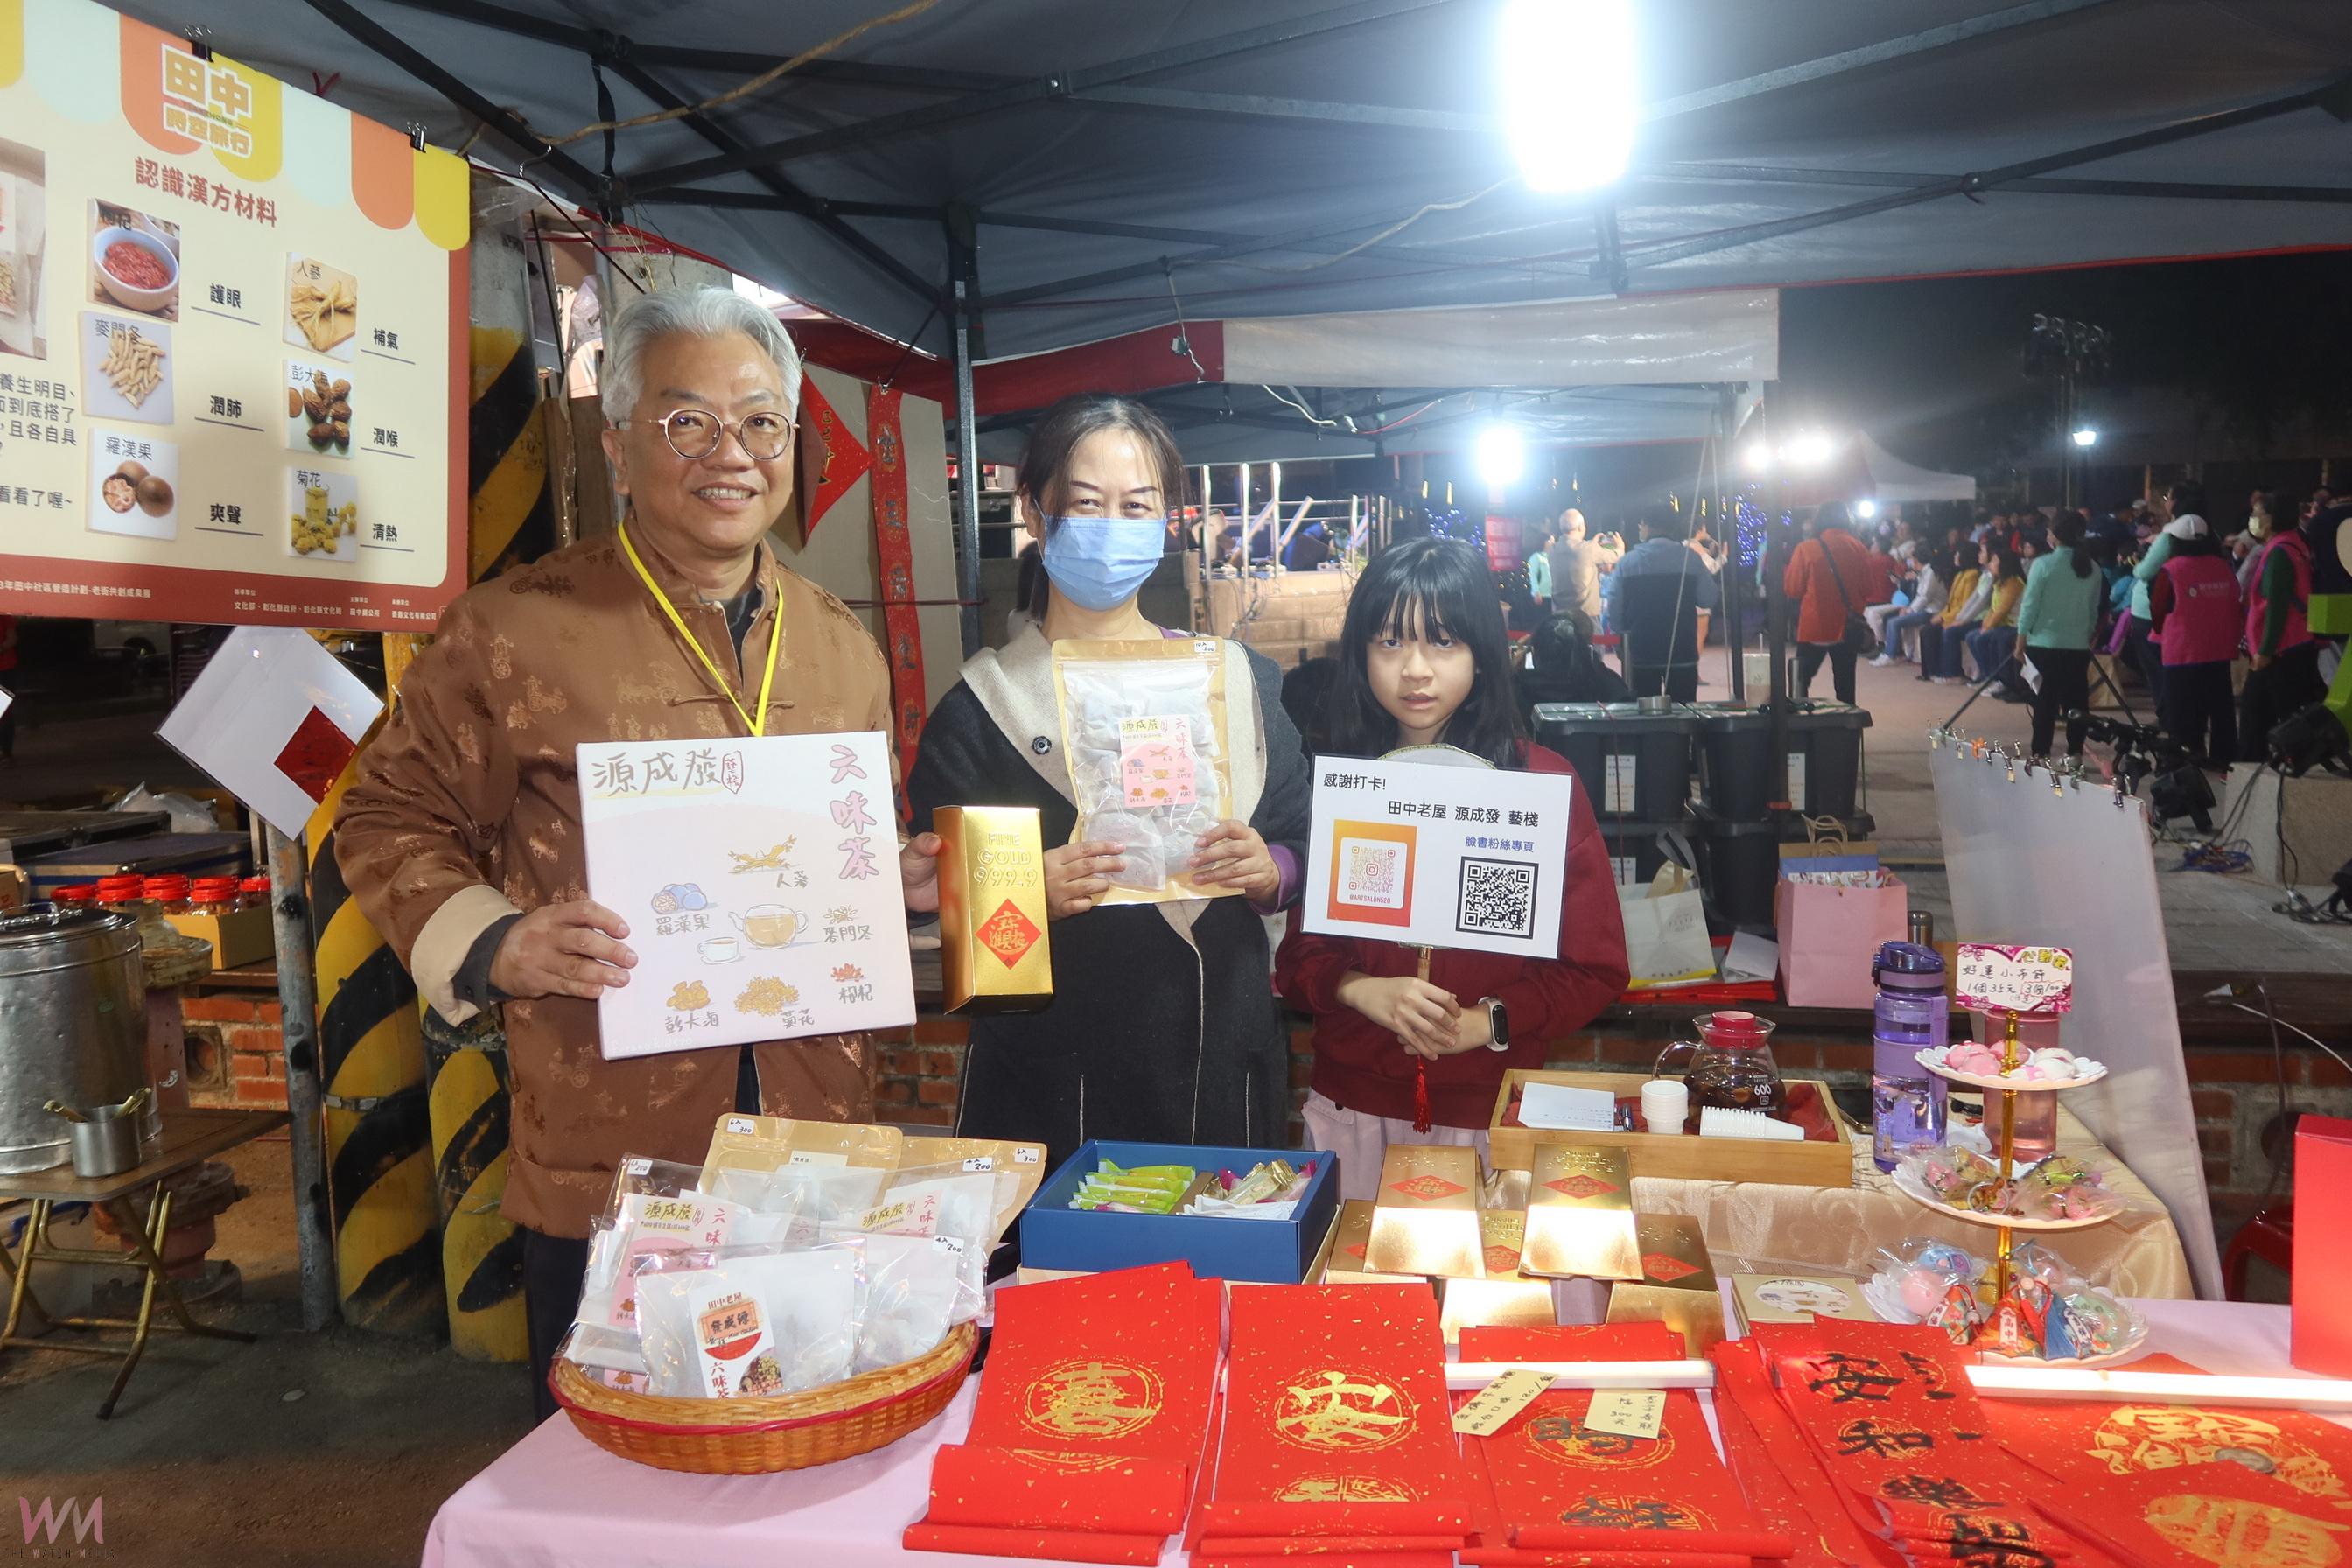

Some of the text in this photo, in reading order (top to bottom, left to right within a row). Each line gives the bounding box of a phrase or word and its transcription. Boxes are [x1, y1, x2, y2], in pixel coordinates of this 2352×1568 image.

[161, 43, 252, 121] 田中
[134, 156, 277, 228] 認識漢方材料
[209, 283, 242, 310] 護眼
[373, 327, 399, 351] 補氣
[209, 395, 242, 419] 潤肺
[373, 426, 399, 448] 潤喉
[104, 436, 153, 462] 羅漢果
[296, 470, 322, 488] 菊花
[209, 502, 242, 525] 爽聲
[372, 524, 399, 543] 清熱
[591, 747, 721, 797] 源成發
[1323, 772, 1387, 792] 感謝打卡!
[828, 743, 880, 880] 六味茶
[1388, 800, 1540, 828] 田中老屋 源成發 藝棧
[988, 832, 1020, 846] FINE
[1465, 835, 1535, 853] 臉書粉絲專頁
[977, 848, 1032, 866] GOLD
[973, 866, 1038, 888] 999.9
[1348, 894, 1391, 905] @ARTSALON520
[655, 913, 711, 936] 羅漢果
[822, 924, 874, 944] 麥門冬
[838, 983, 874, 1004] 枸杞
[664, 1010, 720, 1035] 彭大海
[780, 1008, 816, 1029] 菊花
[1754, 1084, 1772, 1096] 600
[644, 1200, 693, 1221] 源成發
[861, 1203, 904, 1227] 源成發
[947, 1242, 962, 1253] 200
[707, 1292, 743, 1310] 田中老屋
[1030, 1362, 1158, 1437] 喜
[1276, 1370, 1411, 1447] 安
